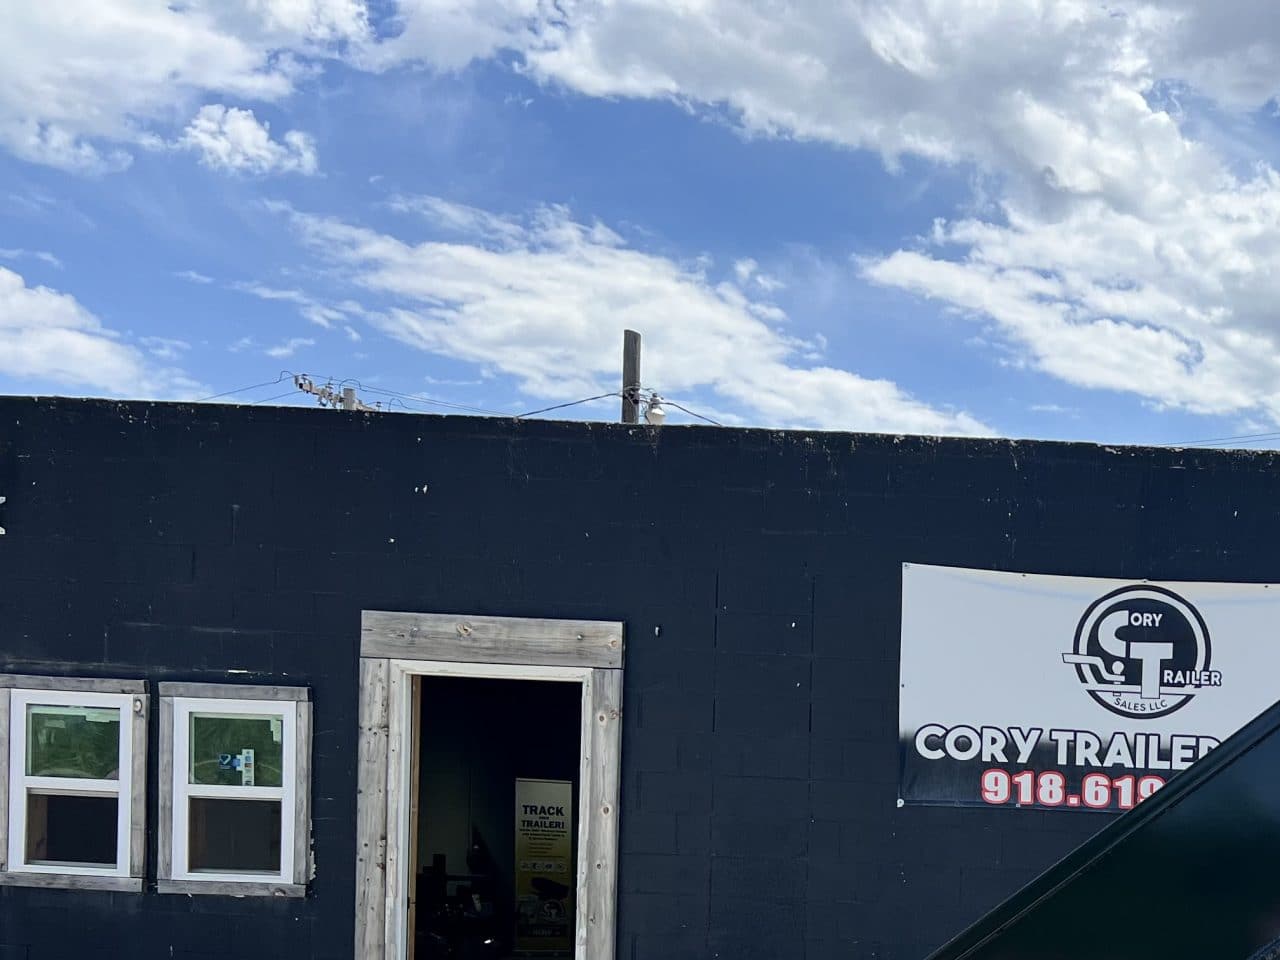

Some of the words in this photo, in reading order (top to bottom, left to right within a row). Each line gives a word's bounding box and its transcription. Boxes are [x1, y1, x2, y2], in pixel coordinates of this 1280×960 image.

[1114, 697, 1146, 712] SALES
[1149, 699, 1168, 711] LLC
[915, 723, 1043, 764] CORY
[522, 804, 565, 817] TRACK
